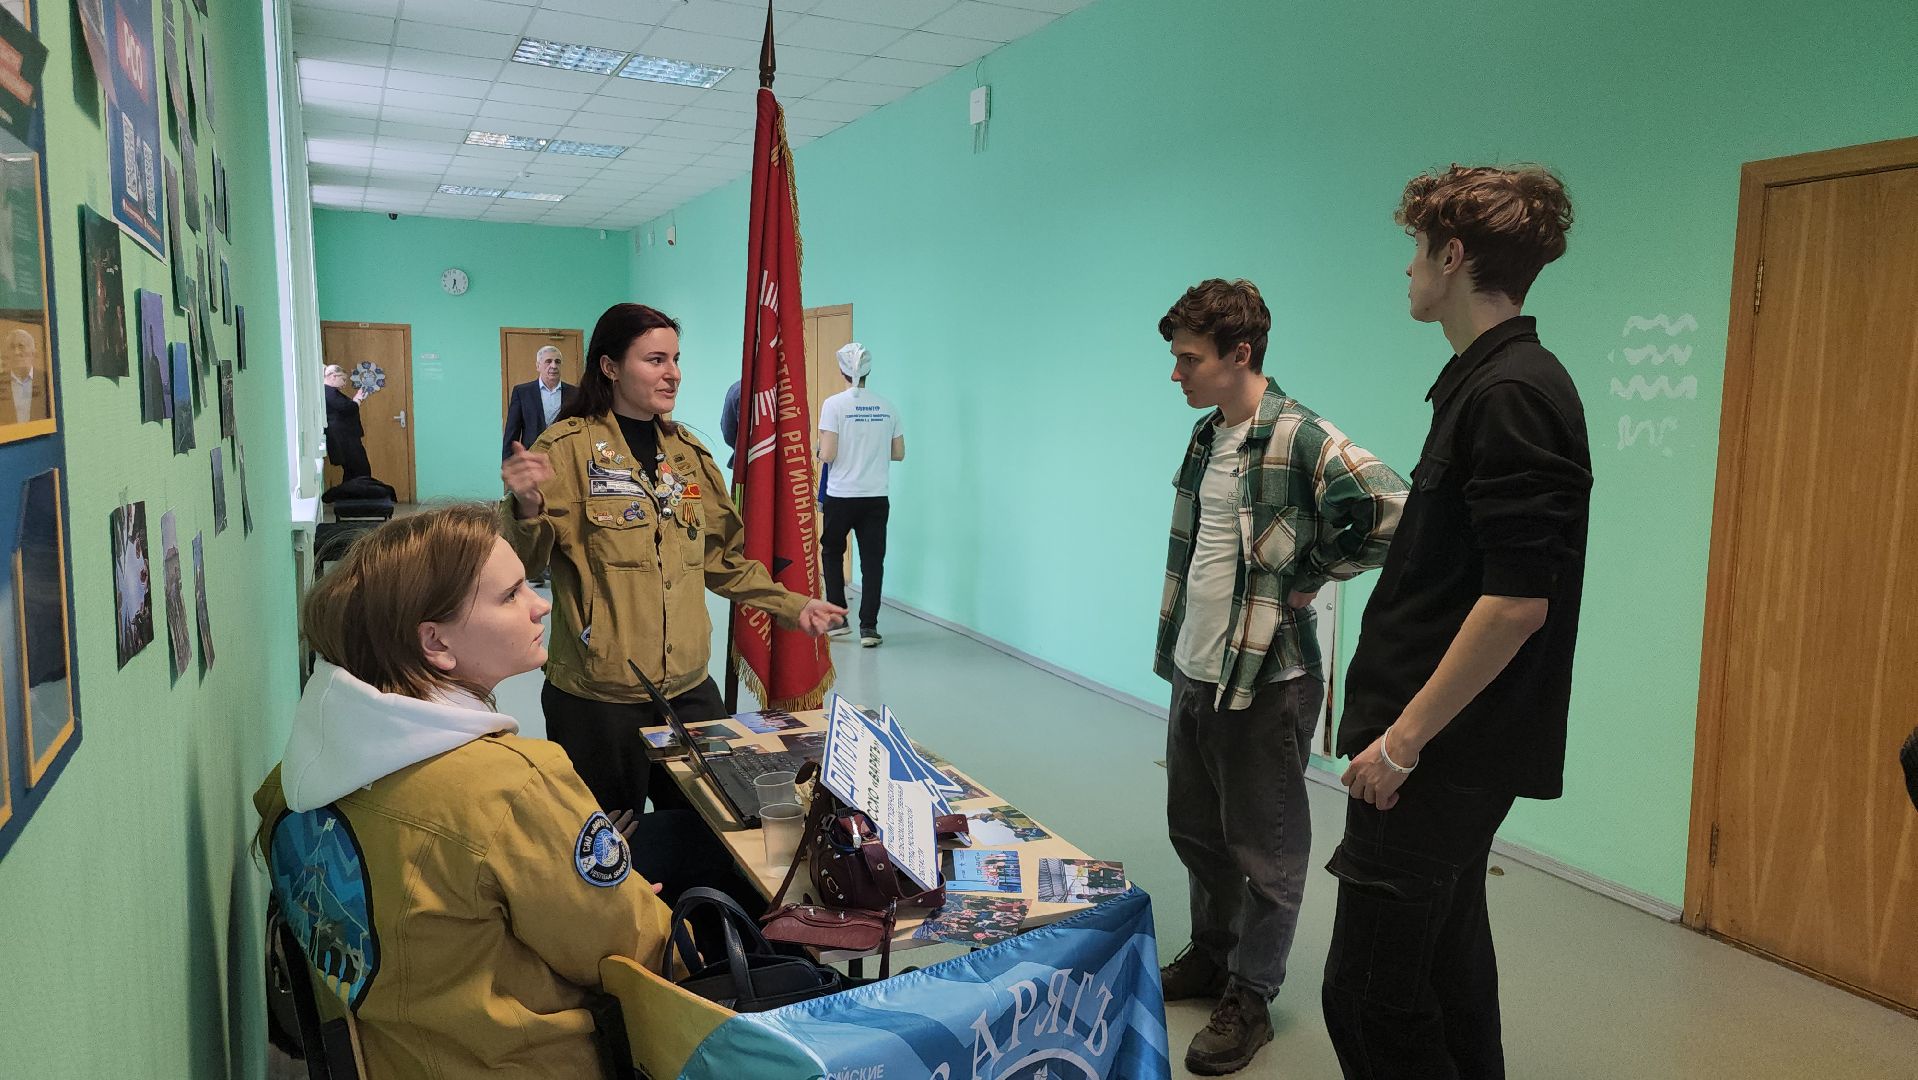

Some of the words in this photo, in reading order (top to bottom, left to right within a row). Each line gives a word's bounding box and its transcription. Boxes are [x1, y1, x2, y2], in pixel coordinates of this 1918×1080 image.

[830, 704, 859, 805] ДИПЛОМ
[867, 787, 880, 822] ССХО
[826, 1064, 884, 1080] СИЙСКИЕ
